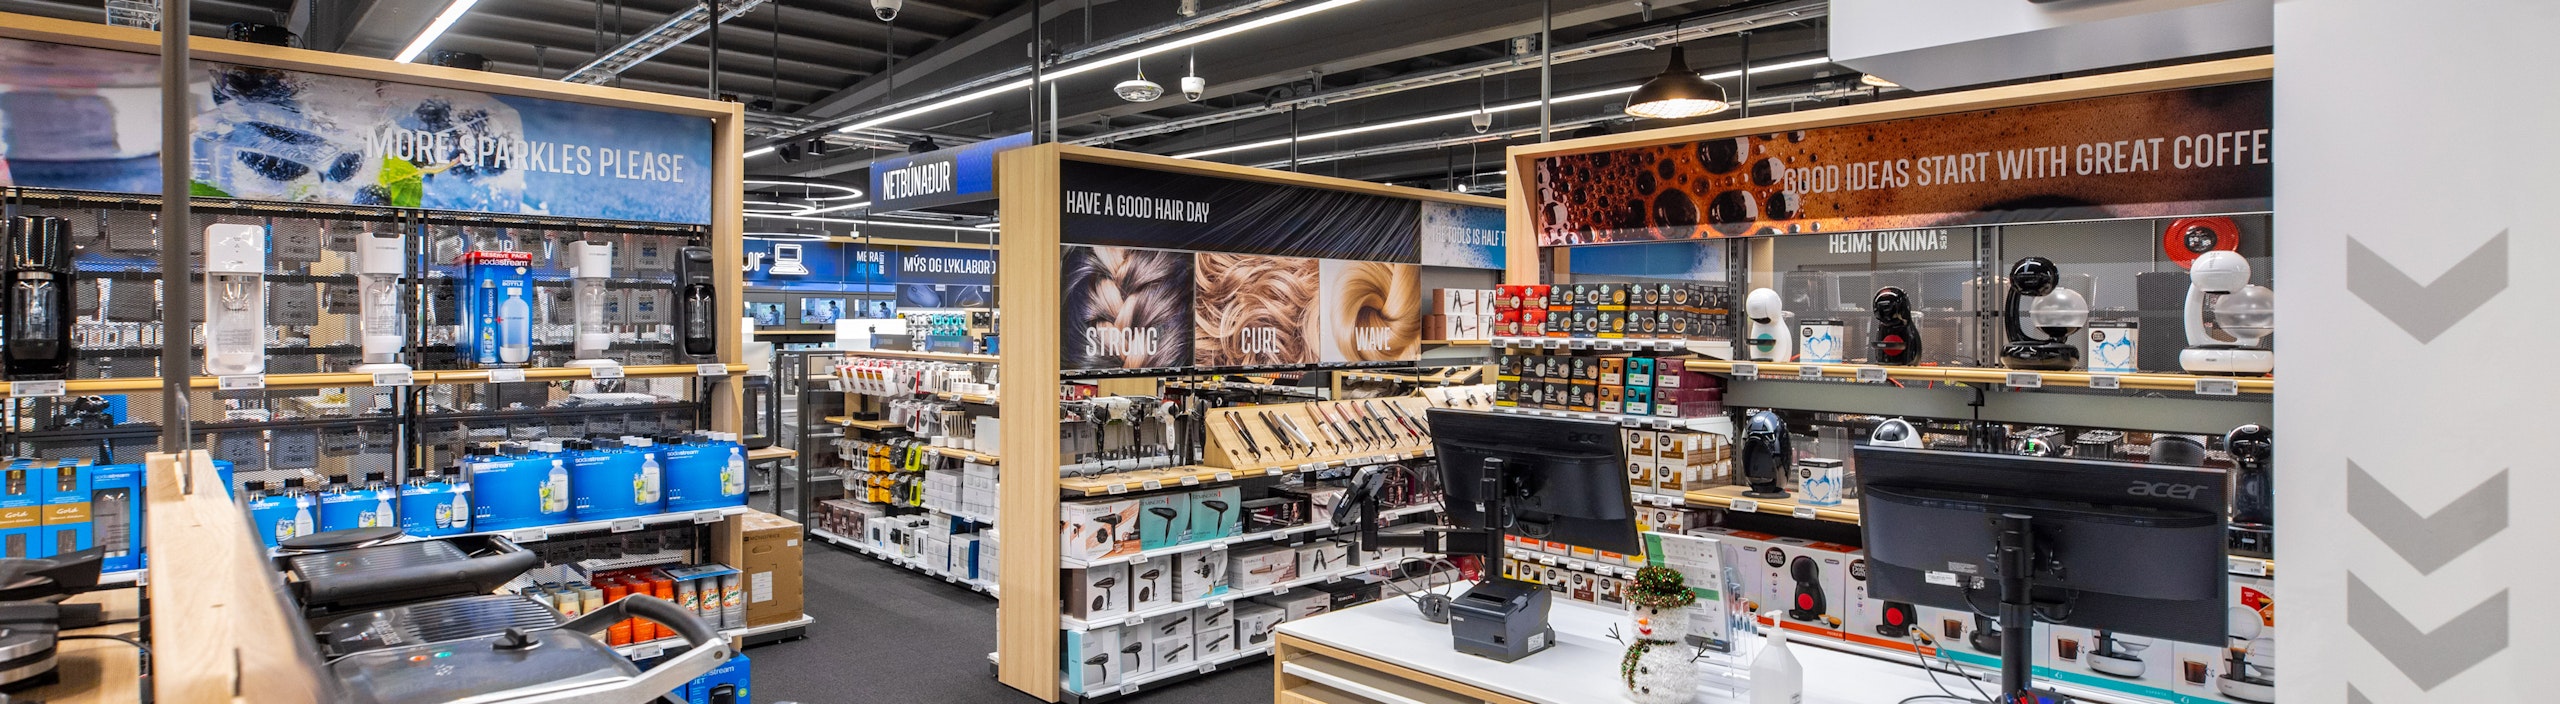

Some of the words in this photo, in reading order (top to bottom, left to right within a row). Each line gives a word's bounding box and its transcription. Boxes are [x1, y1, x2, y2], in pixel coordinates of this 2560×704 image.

[366, 128, 450, 165] MORE
[459, 134, 592, 176] SPARKLES
[600, 147, 685, 183] PLEASE
[1784, 165, 1839, 196] GOOD
[1846, 158, 1909, 192] IDEAS
[1917, 151, 1990, 187] START
[1996, 145, 2067, 182] WITH
[2075, 137, 2165, 176] GREAT
[2174, 129, 2274, 170] COFFE
[883, 160, 950, 201] NETBÚNAÐUR
[1066, 190, 1101, 215] HAVE
[1104, 194, 1114, 216] A
[1117, 195, 1151, 219] GOOD
[1155, 198, 1184, 222] HAIR
[1186, 201, 1209, 224] DAY
[1432, 225, 1445, 243] THE
[1448, 226, 1471, 245] TOOLS
[1472, 228, 1480, 245] IS
[1481, 229, 1499, 247] HALF
[480, 258, 528, 267] sodastream
[856, 251, 879, 262] MERA
[904, 255, 926, 273] MÝS
[928, 257, 942, 273] OG
[856, 261, 879, 275] ÚRAL
[1086, 326, 1158, 357] STRONG
[1241, 327, 1280, 354] CURL
[1355, 326, 1391, 351] WAVE
[2127, 480, 2209, 500] acer
[56, 507, 79, 515] Gold
[703, 666, 735, 677] stream
